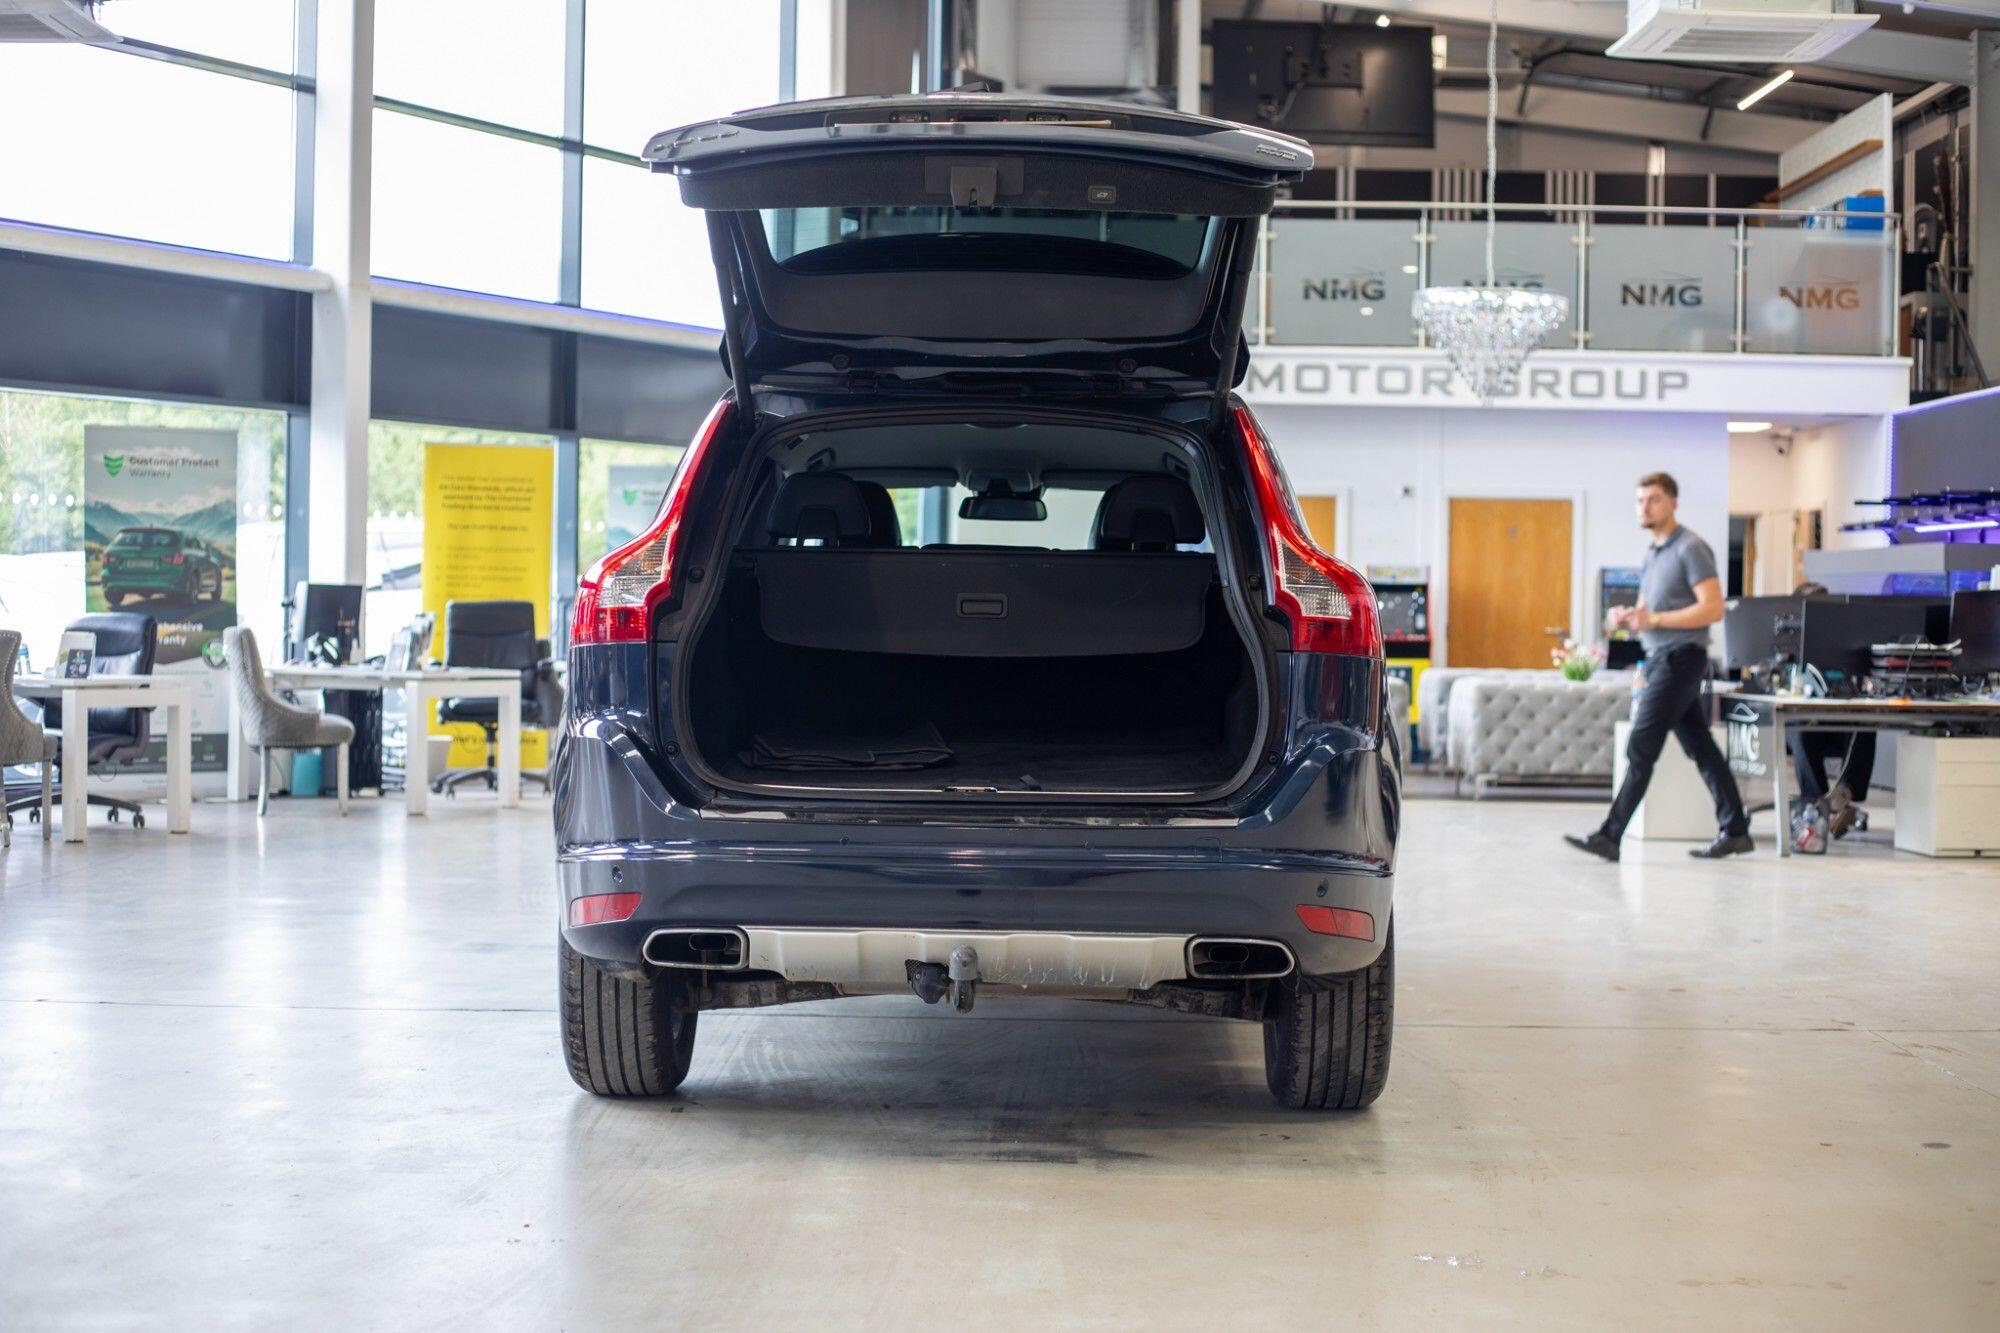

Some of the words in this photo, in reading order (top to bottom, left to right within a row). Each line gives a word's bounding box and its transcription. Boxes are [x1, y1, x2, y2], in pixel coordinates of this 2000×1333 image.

[1303, 278, 1387, 301] NMG
[1621, 283, 1703, 307] NMG
[1778, 286, 1860, 309] NMG
[1246, 363, 1454, 395] MOTOR
[129, 455, 179, 467] Customer
[181, 457, 219, 468] Protect
[129, 467, 171, 480] Warranty
